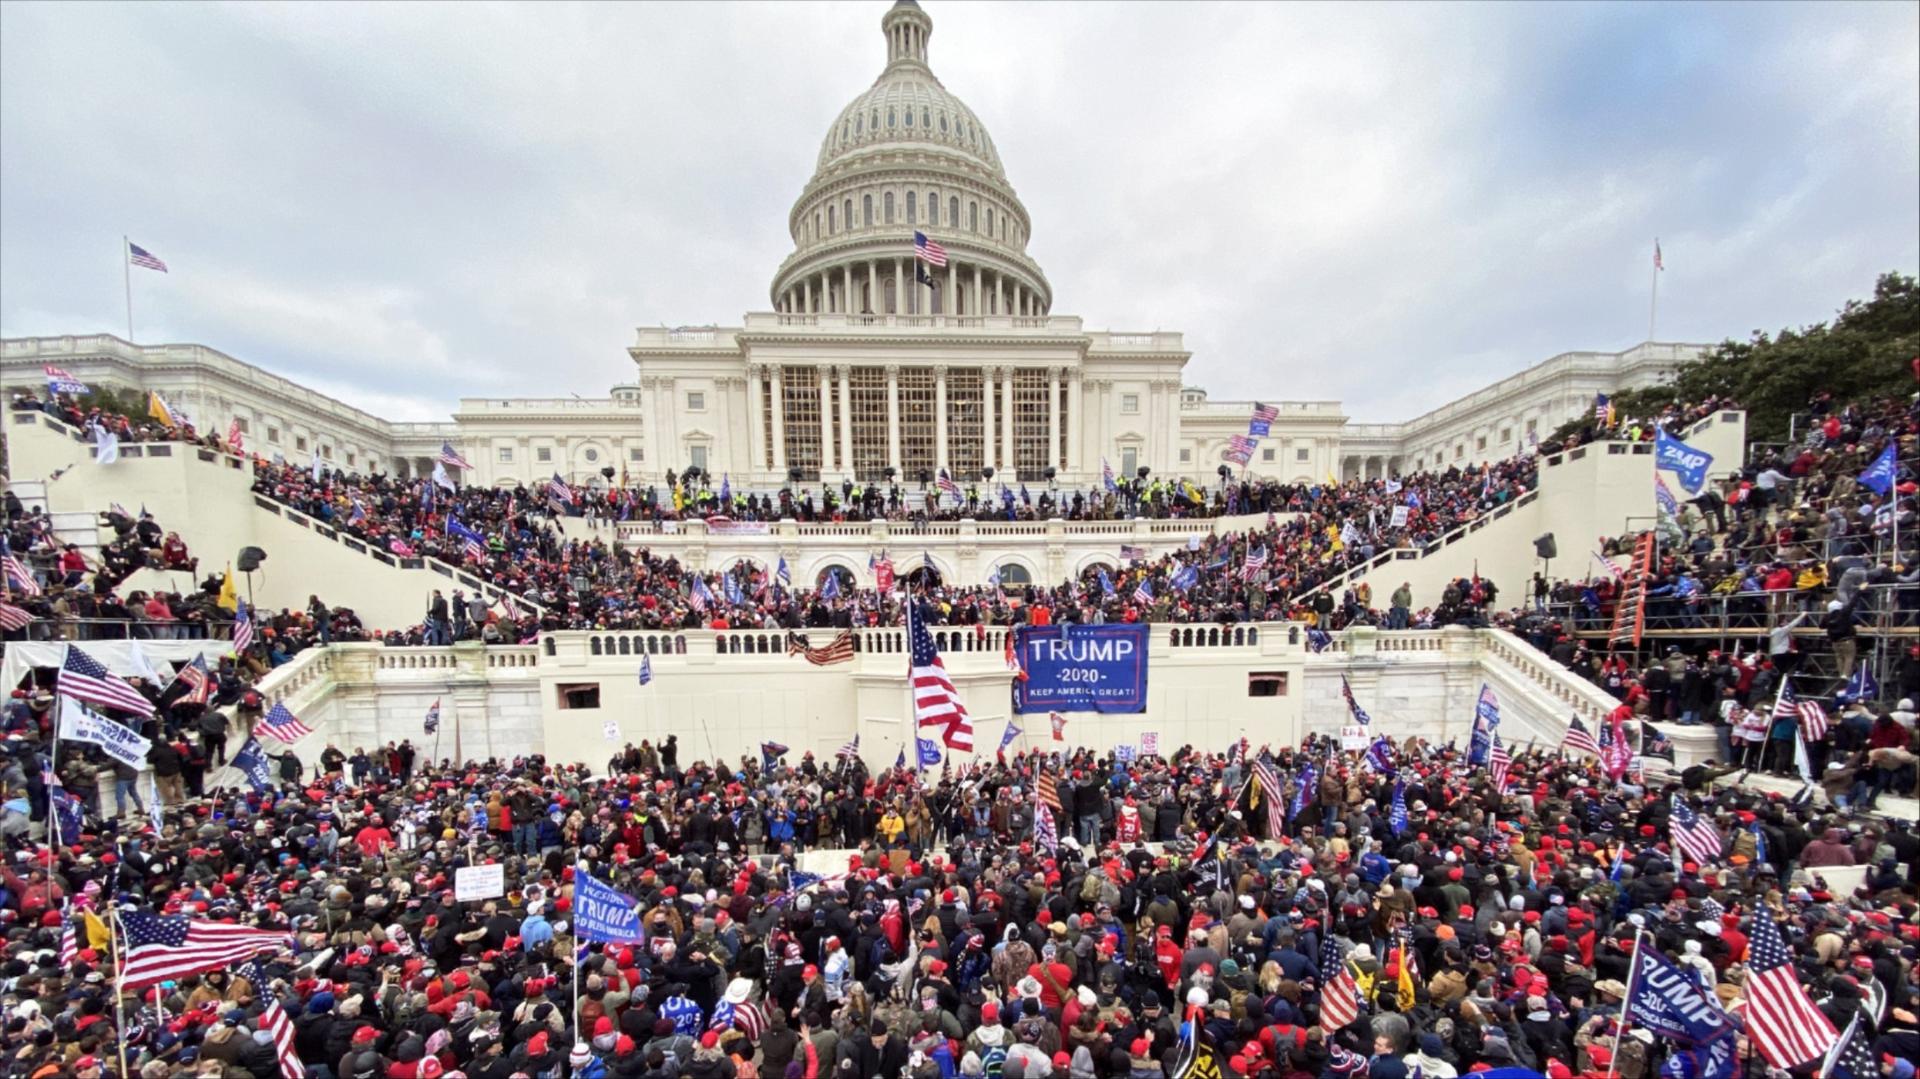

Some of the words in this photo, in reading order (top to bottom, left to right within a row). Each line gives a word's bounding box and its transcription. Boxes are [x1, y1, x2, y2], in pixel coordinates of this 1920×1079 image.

[1029, 639, 1133, 662] TRUMP
[1030, 688, 1054, 696] KEEP
[1098, 688, 1135, 697] GREAT!
[578, 895, 634, 927] TRUMP
[1640, 951, 1722, 1026] RUMP
